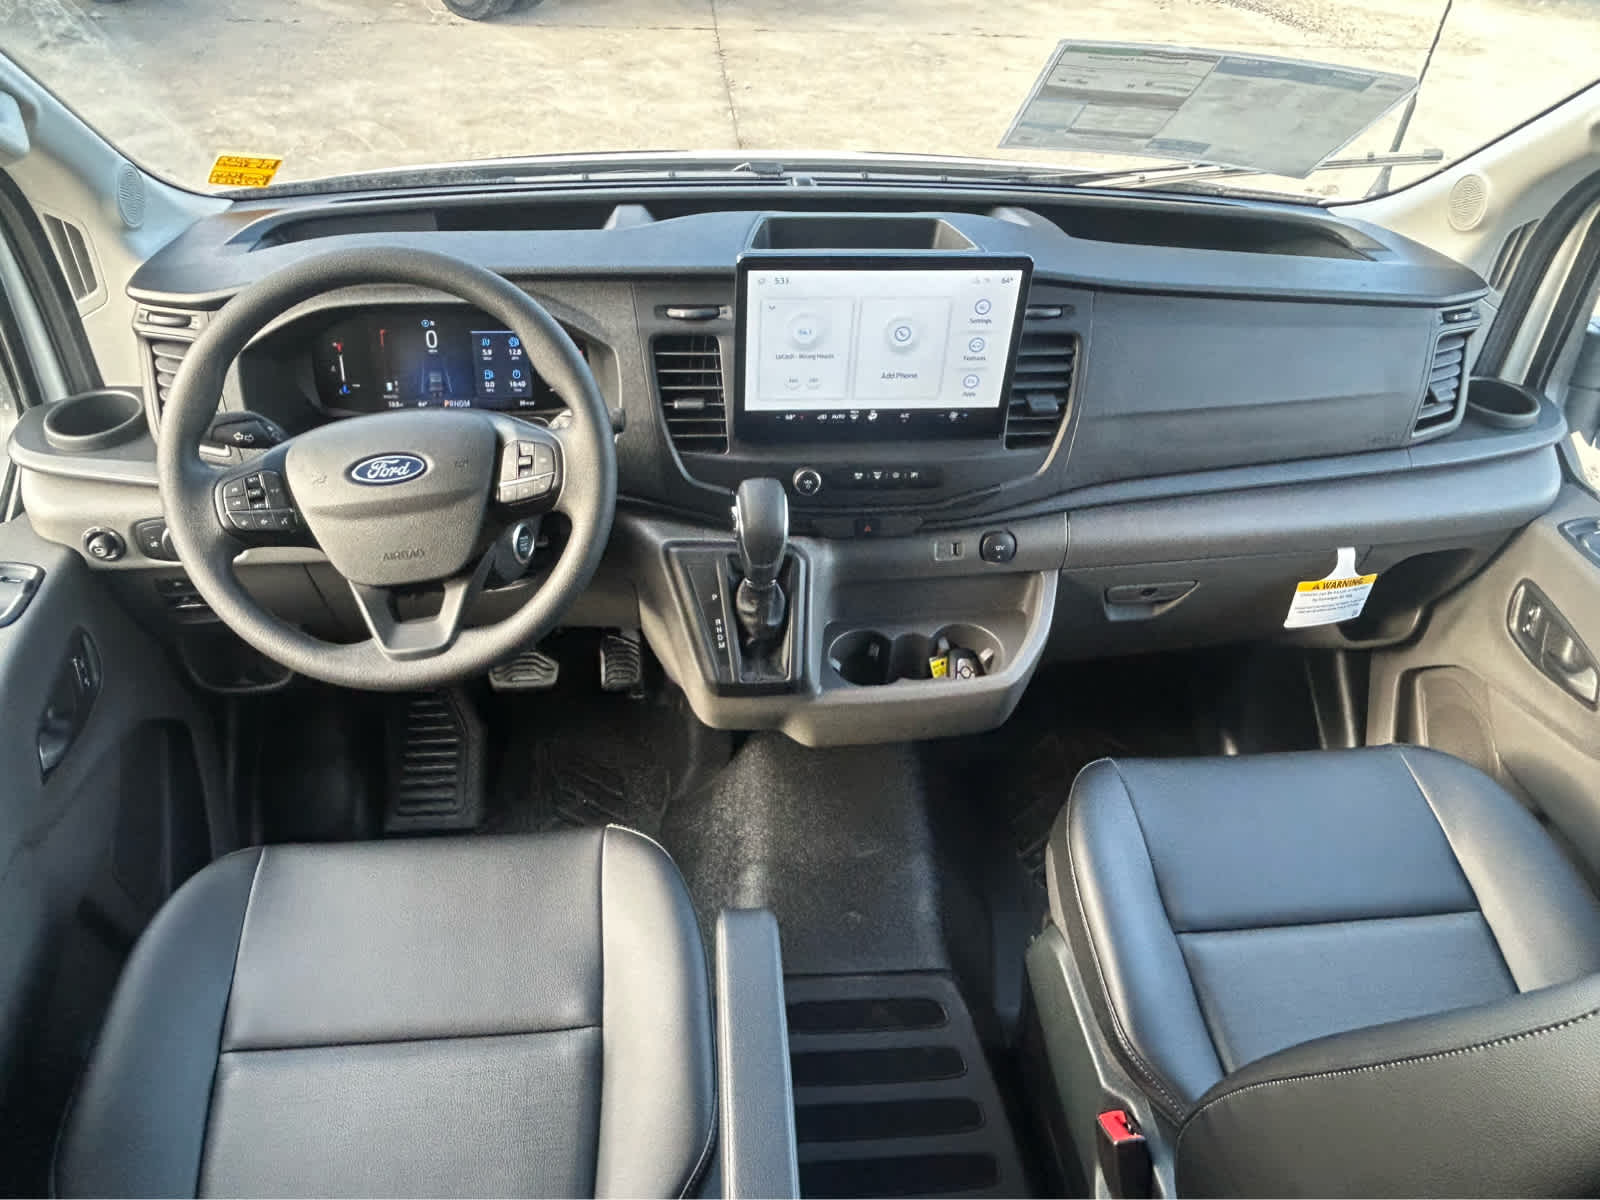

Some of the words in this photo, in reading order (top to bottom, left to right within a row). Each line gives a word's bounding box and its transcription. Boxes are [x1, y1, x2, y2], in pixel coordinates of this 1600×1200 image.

[969, 317, 992, 325] Settings
[425, 330, 438, 348] 0
[881, 371, 896, 379] Add
[896, 371, 918, 379] Phone
[367, 459, 410, 479] Ford
[1323, 578, 1364, 590] WARNING
